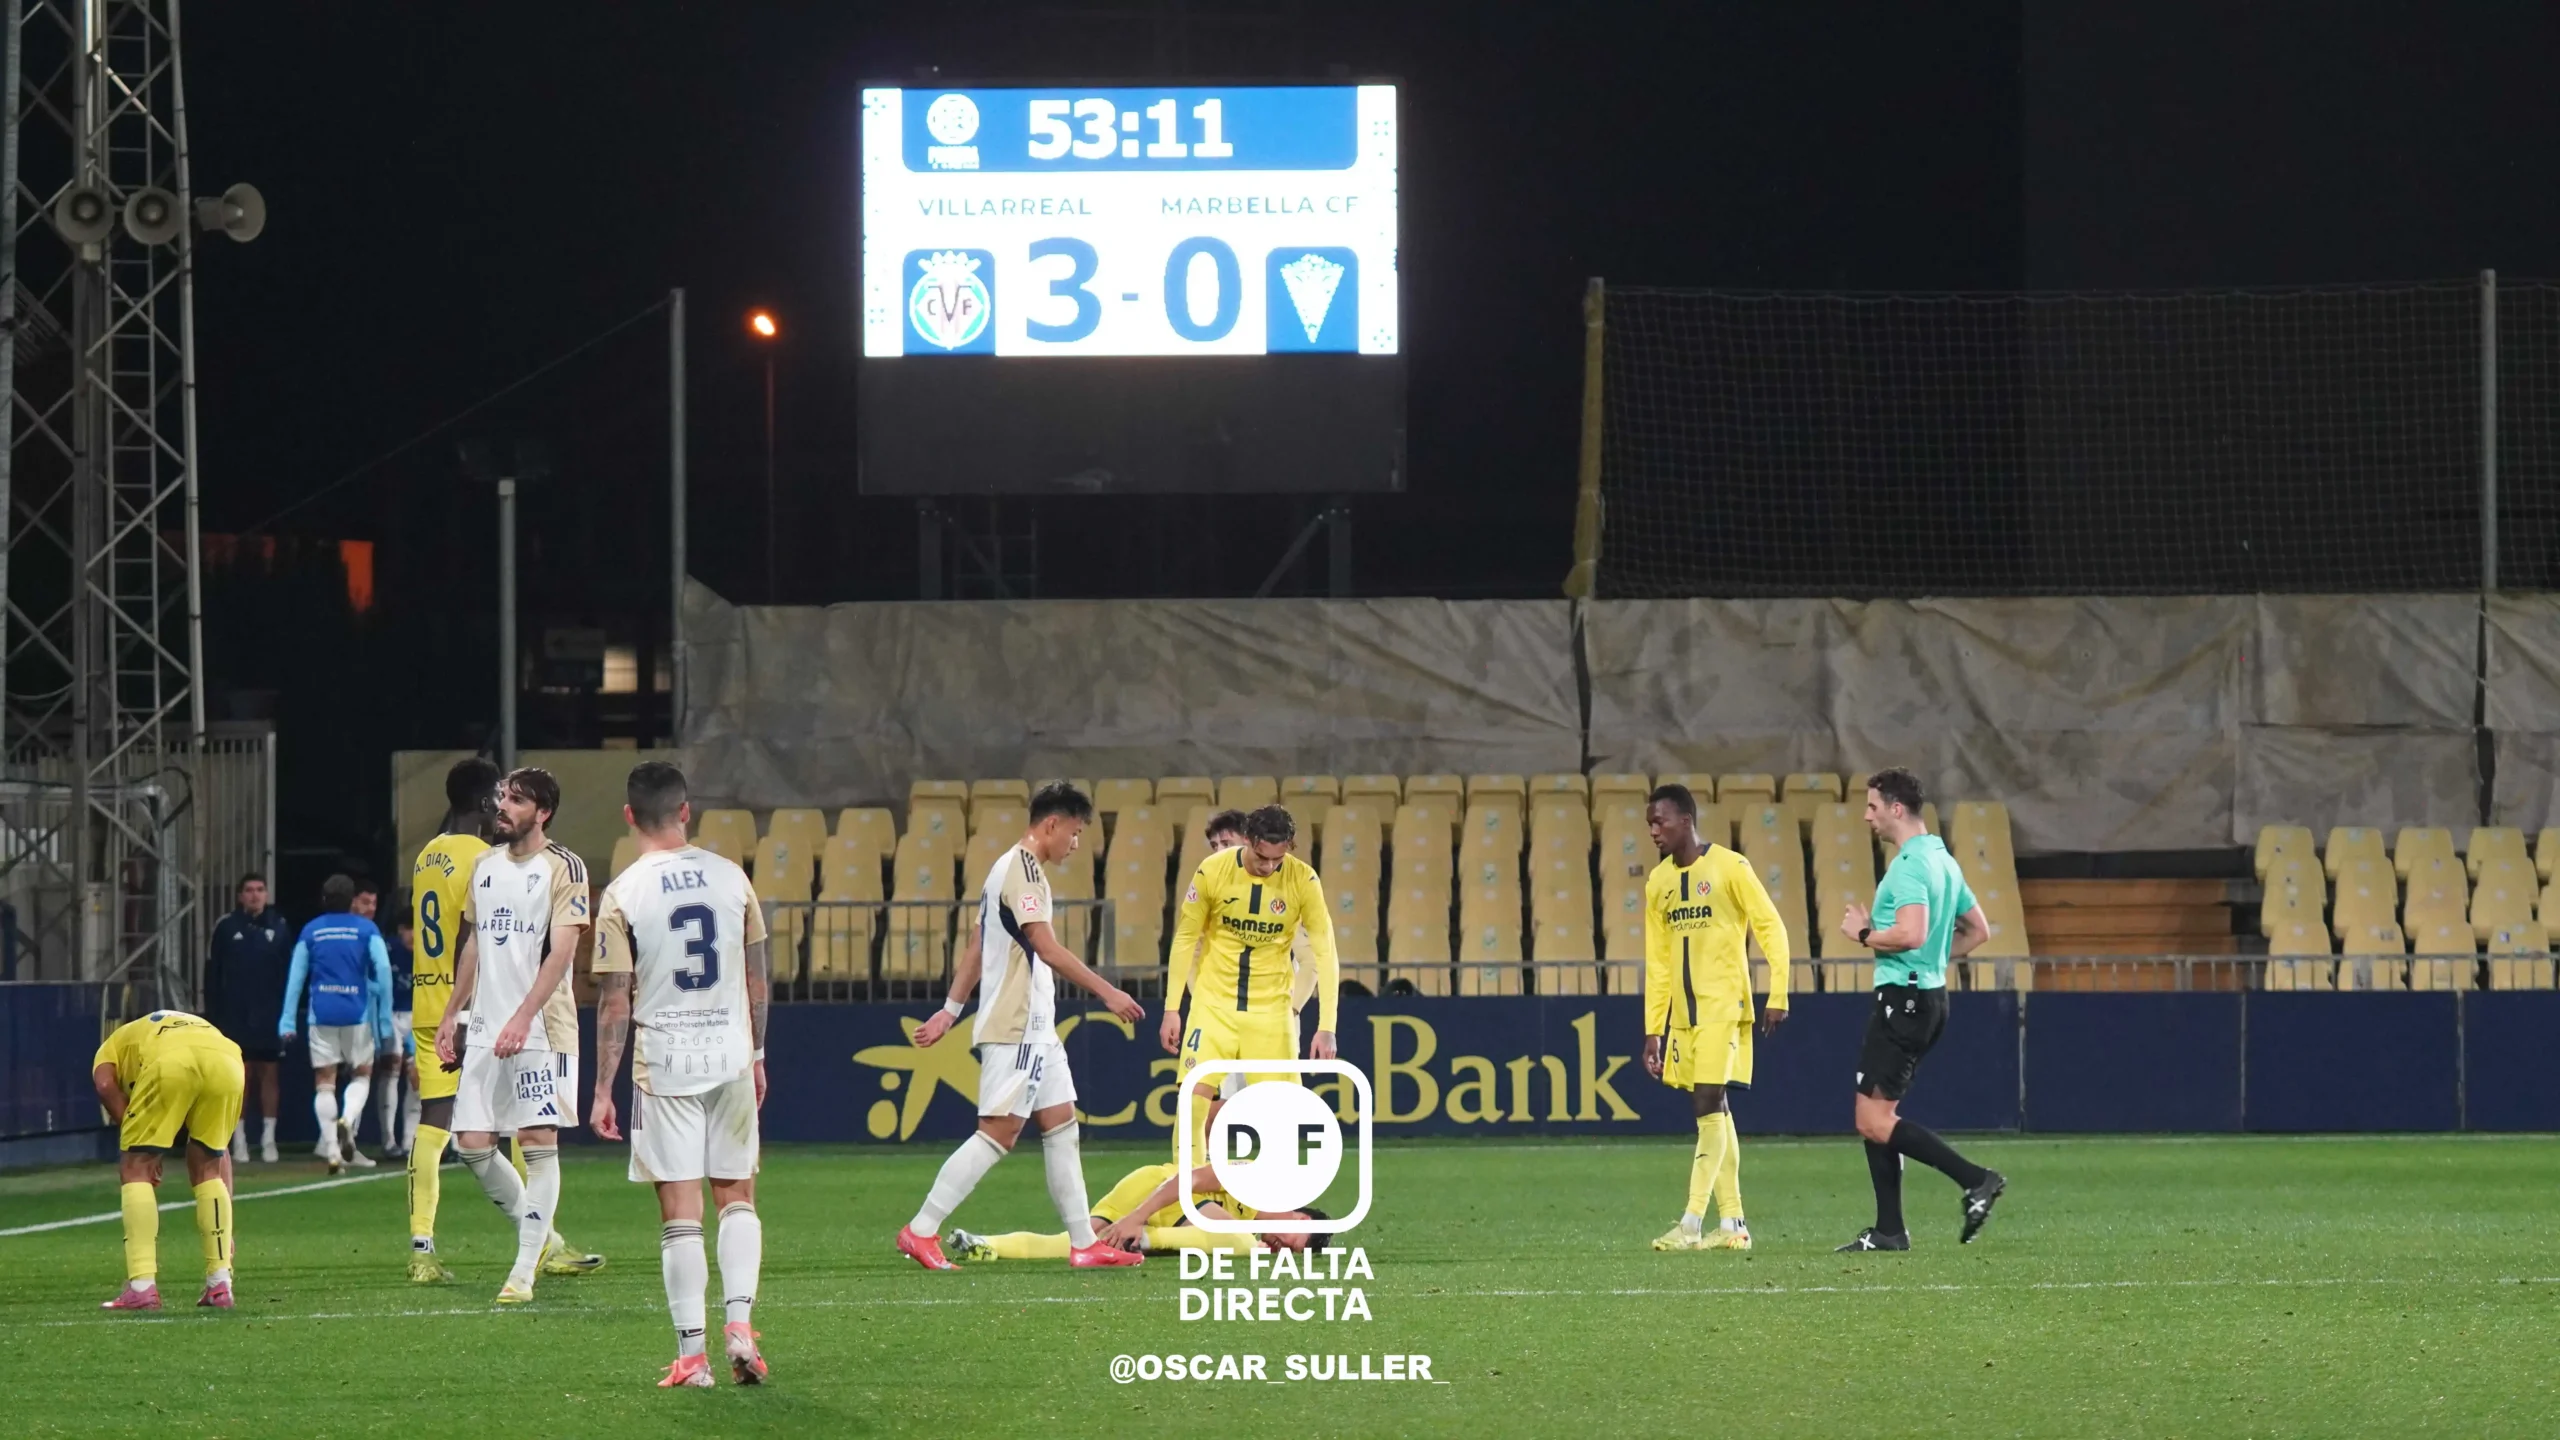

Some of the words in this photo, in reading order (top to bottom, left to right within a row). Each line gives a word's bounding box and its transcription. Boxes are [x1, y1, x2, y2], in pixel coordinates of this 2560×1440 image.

[1028, 98, 1233, 160] 53:11
[918, 199, 1092, 216] VILLARREAL
[1161, 197, 1314, 215] MARBELLA
[1326, 196, 1358, 214] CF
[1026, 236, 1103, 343] 3
[1163, 235, 1243, 343] 0
[426, 851, 456, 878] DIATTA
[661, 869, 709, 894] ÁLEX
[421, 890, 444, 958] 8
[1221, 914, 1285, 935] PAMESA
[668, 902, 721, 993] 3
[655, 1008, 730, 1019] PORSCHE
[655, 1021, 679, 1030] Centro
[680, 1019, 706, 1029] Porsche
[667, 1035, 724, 1047] GRUPO
[1187, 1027, 1202, 1053] 4
[1672, 1038, 1680, 1064] 5
[664, 1052, 728, 1076] MOSH
[1029, 1053, 1044, 1082] 18
[516, 1081, 555, 1102] laga
